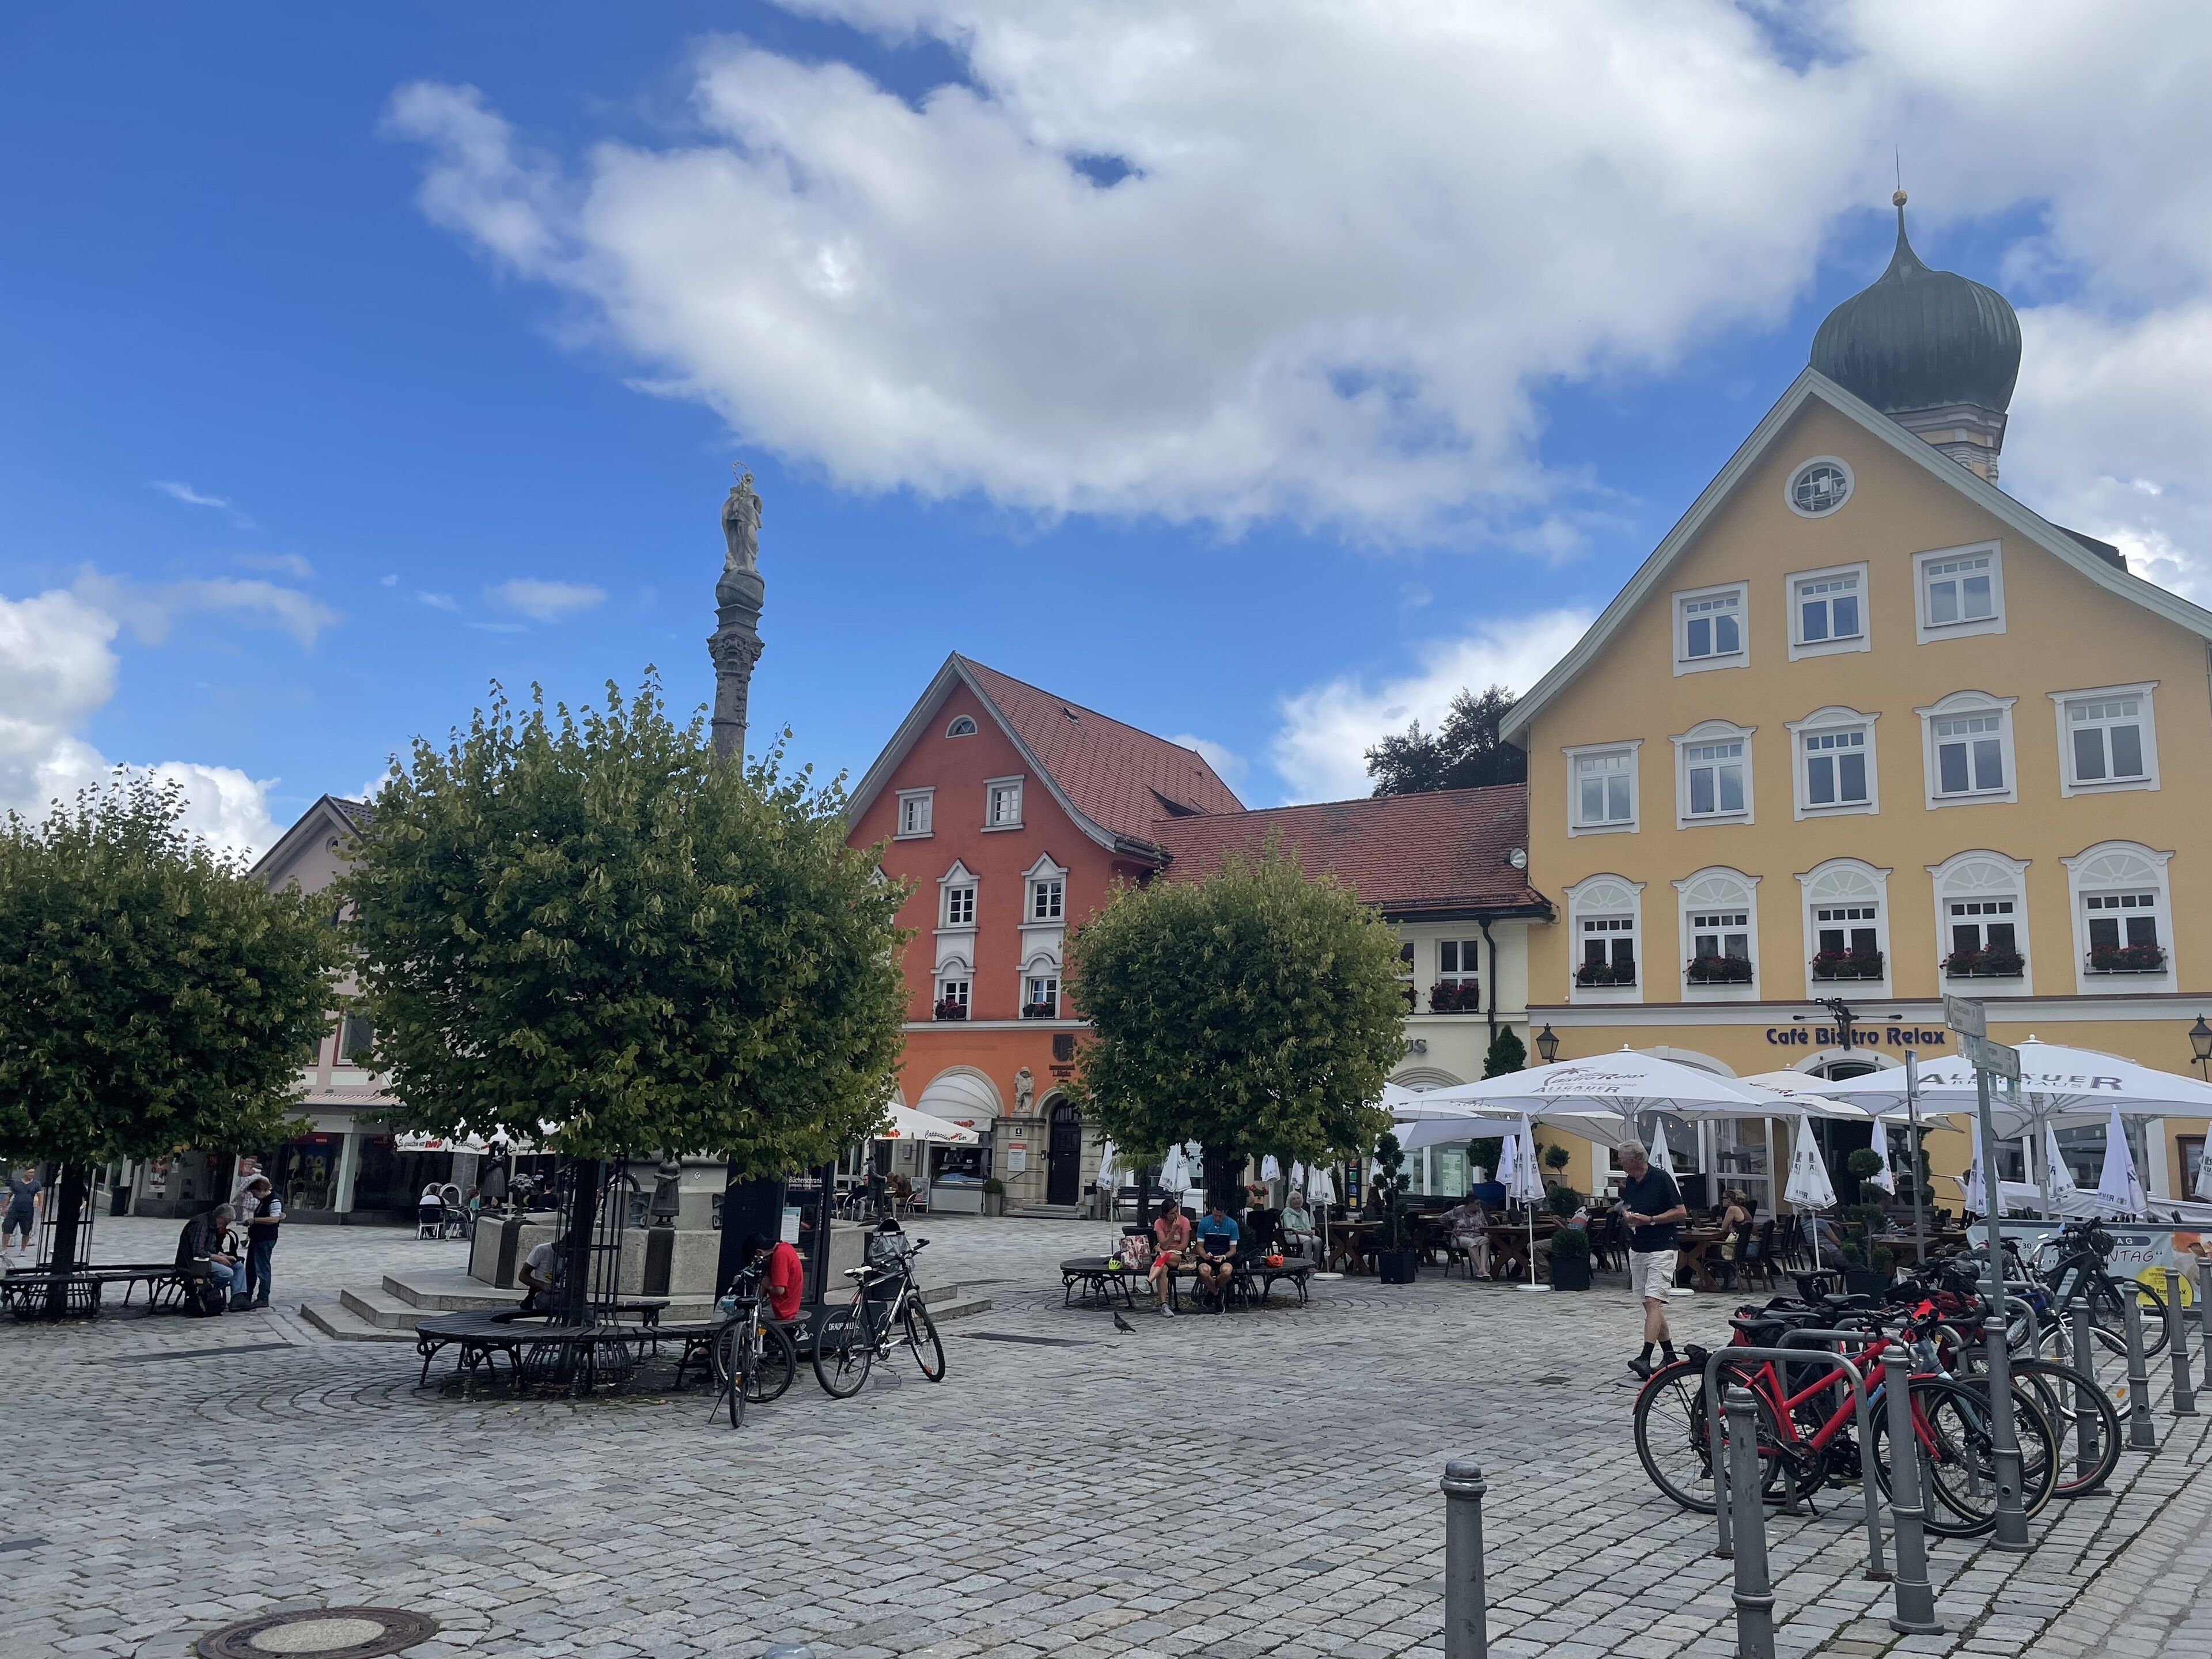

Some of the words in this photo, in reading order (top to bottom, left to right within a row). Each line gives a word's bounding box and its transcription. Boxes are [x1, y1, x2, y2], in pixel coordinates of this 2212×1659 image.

[1766, 1028, 1808, 1045] Café
[1887, 1027, 1945, 1046] Relax
[789, 1175, 823, 1184] Bücherschrank
[2105, 1249, 2163, 1263] NTAG“
